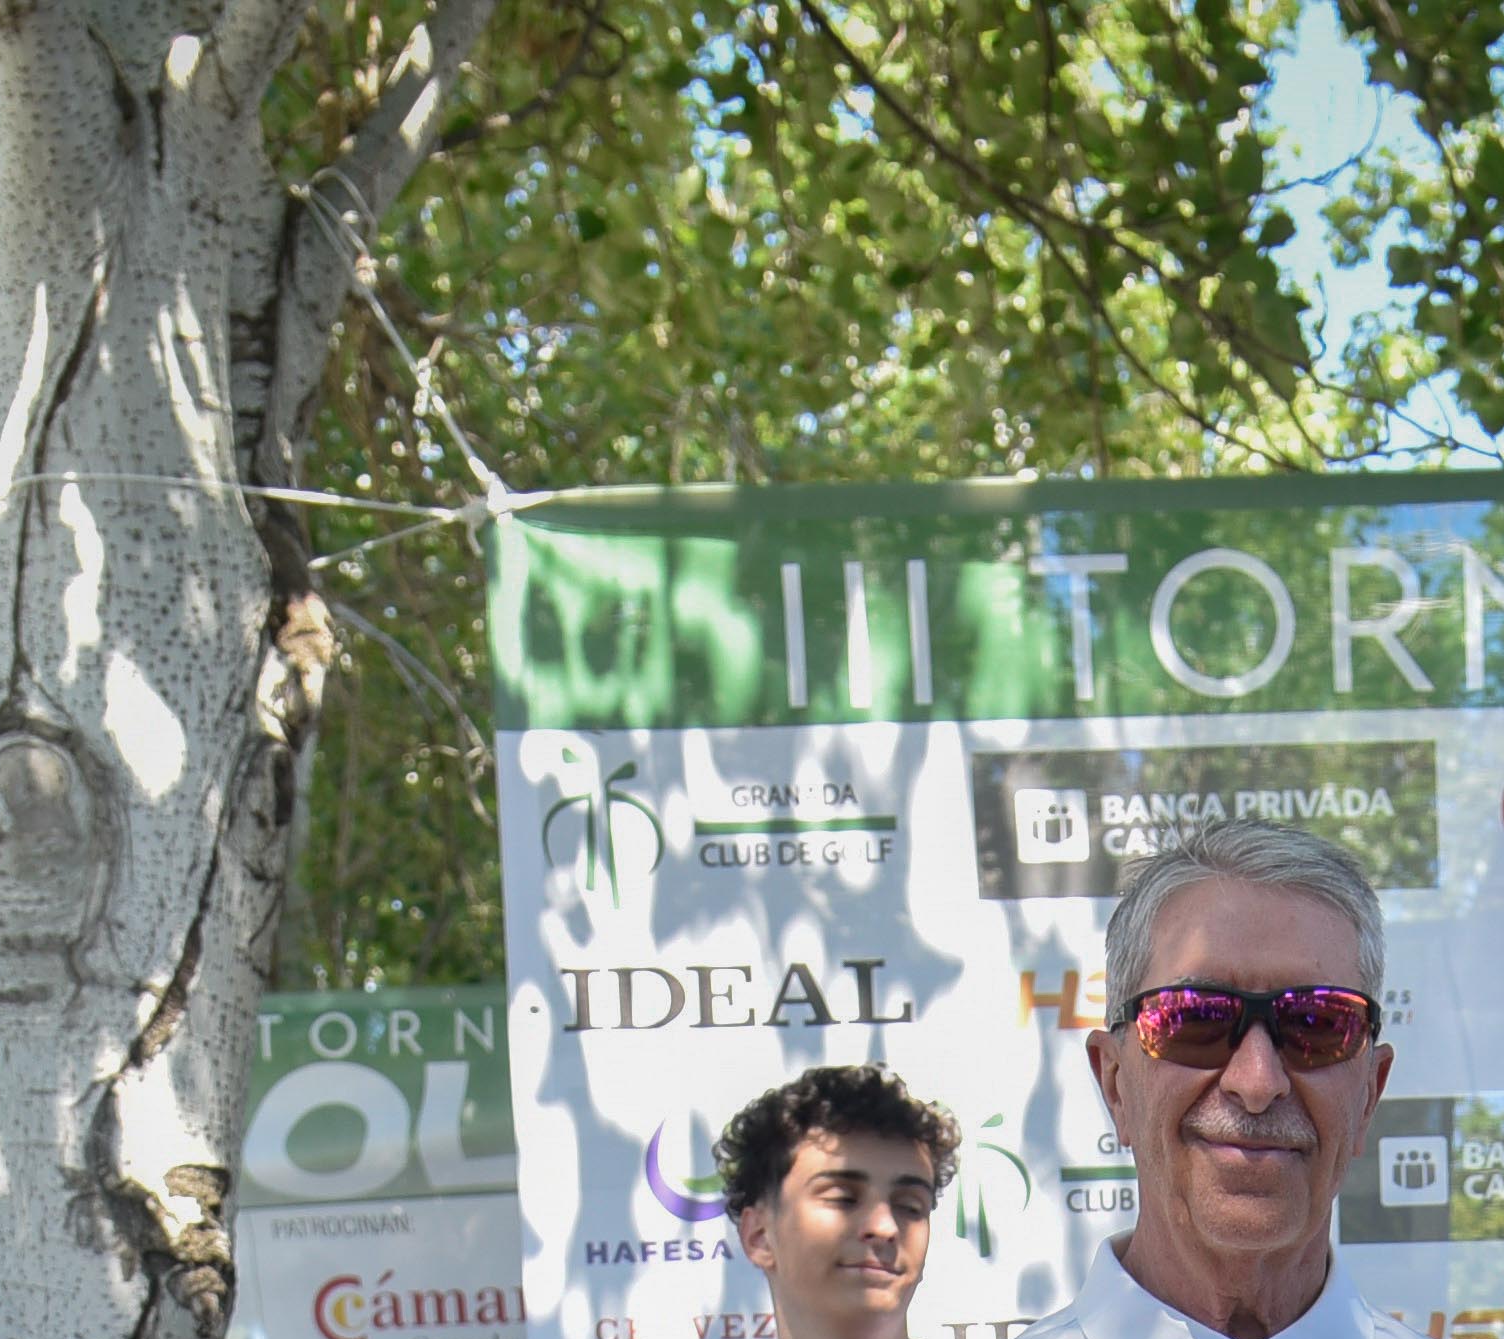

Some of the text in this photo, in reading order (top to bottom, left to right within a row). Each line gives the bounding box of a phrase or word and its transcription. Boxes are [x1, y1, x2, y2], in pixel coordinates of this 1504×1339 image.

[781, 559, 933, 709] III
[730, 783, 859, 808] GRANDA
[1099, 791, 1226, 825] BANCA
[698, 837, 894, 868] CLUB DE GLF
[559, 957, 913, 1033] IDEAL
[254, 1005, 496, 1062] TORN
[242, 1060, 518, 1199] OL
[1066, 1187, 1135, 1214] CLUB
[585, 1239, 734, 1265] HAFESA
